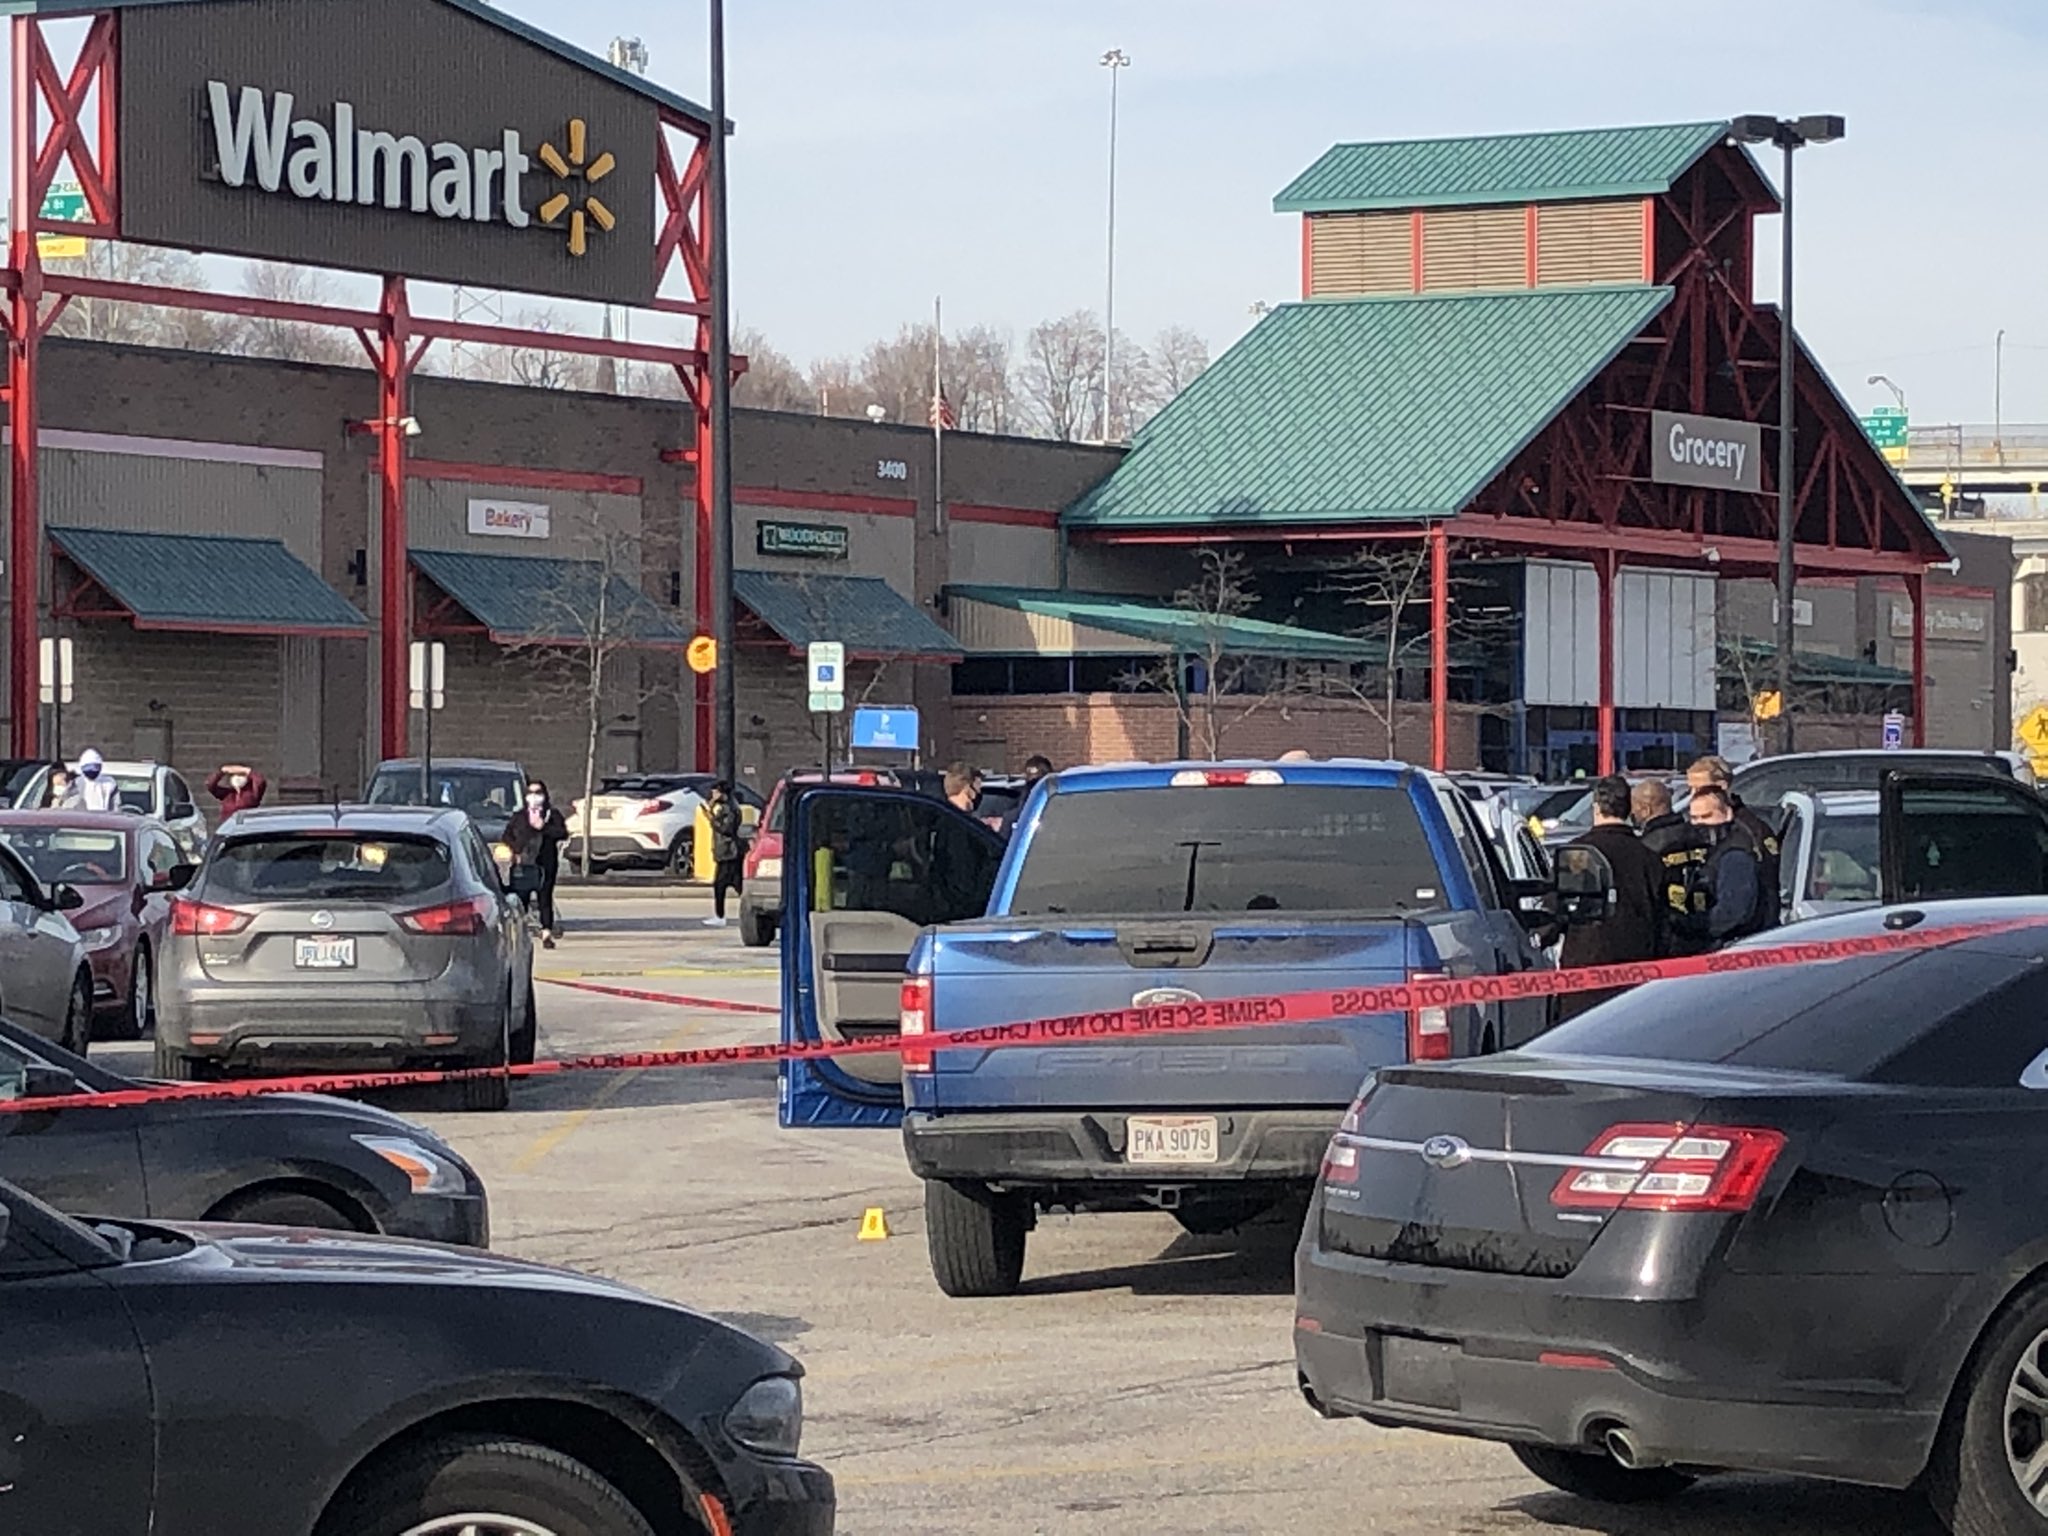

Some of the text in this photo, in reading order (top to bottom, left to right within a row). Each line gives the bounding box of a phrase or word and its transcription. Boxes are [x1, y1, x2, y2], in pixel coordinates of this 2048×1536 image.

[207, 80, 530, 228] Walmart
[1669, 423, 1746, 481] Grocery
[877, 460, 907, 480] 3400
[485, 507, 532, 534] Bakery
[1135, 1129, 1211, 1152] PKA 9079
